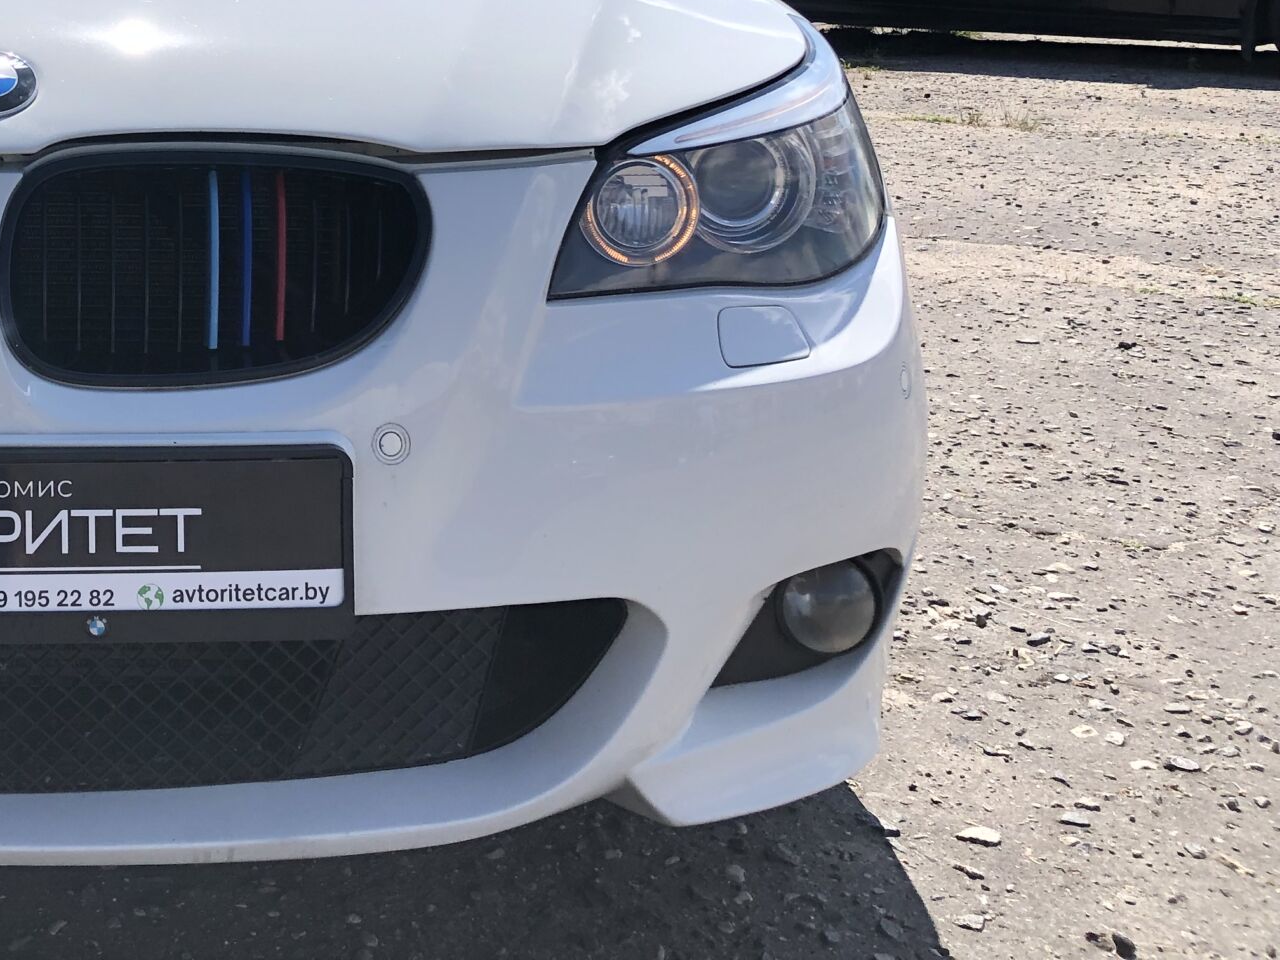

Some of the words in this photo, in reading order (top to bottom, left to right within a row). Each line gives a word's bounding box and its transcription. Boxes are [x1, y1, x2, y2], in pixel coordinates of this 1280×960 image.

[14, 590, 51, 608] 195
[56, 590, 83, 608] 22
[88, 589, 115, 607] 82
[172, 582, 330, 604] avtoritetcar.by
